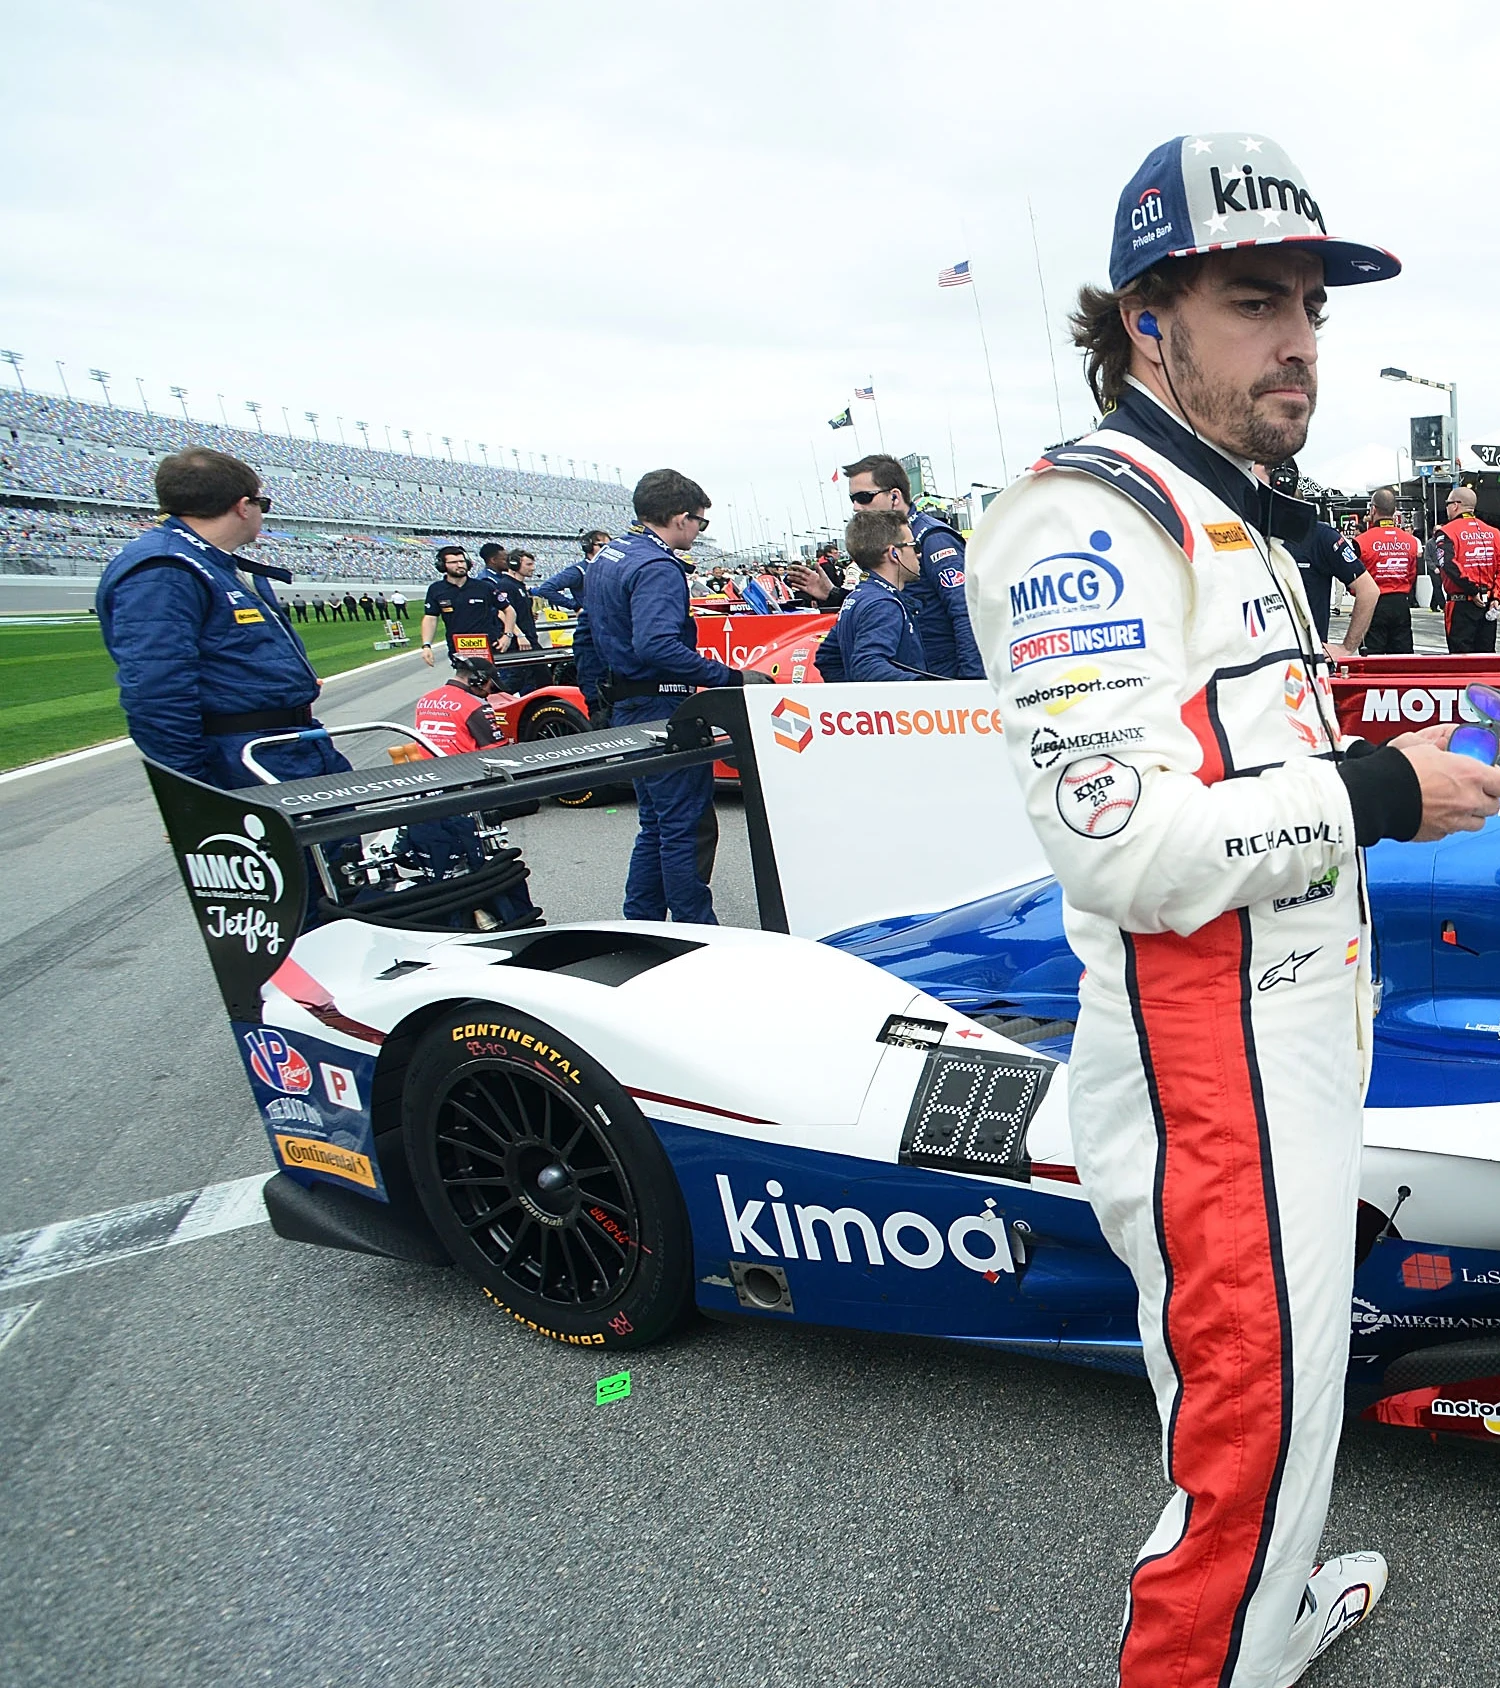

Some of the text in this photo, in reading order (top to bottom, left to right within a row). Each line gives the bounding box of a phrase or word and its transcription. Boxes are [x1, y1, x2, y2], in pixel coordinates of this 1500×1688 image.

[1131, 190, 1163, 231] citi
[1132, 222, 1173, 250] Private Bank
[1481, 446, 1496, 462] 37
[1372, 541, 1411, 552] GAINSCO
[1460, 530, 1494, 541] GAINSCO
[1010, 569, 1099, 618] MMCG
[459, 638, 483, 648] Sabelt
[658, 684, 687, 693] AUTOTEL
[417, 697, 461, 712] GAINSCO
[523, 737, 639, 763] CROWDSTRIKE
[280, 772, 442, 807] CROWDSTRIKE
[1074, 775, 1115, 802] KMB
[1090, 790, 1108, 807] 23
[185, 853, 266, 891] MMCG
[206, 905, 286, 955] Jetfly
[452, 1023, 581, 1084] CONTINENTAL
[330, 1070, 347, 1101] P
[286, 1140, 357, 1173] Continental
[715, 1173, 1015, 1274] kimoa
